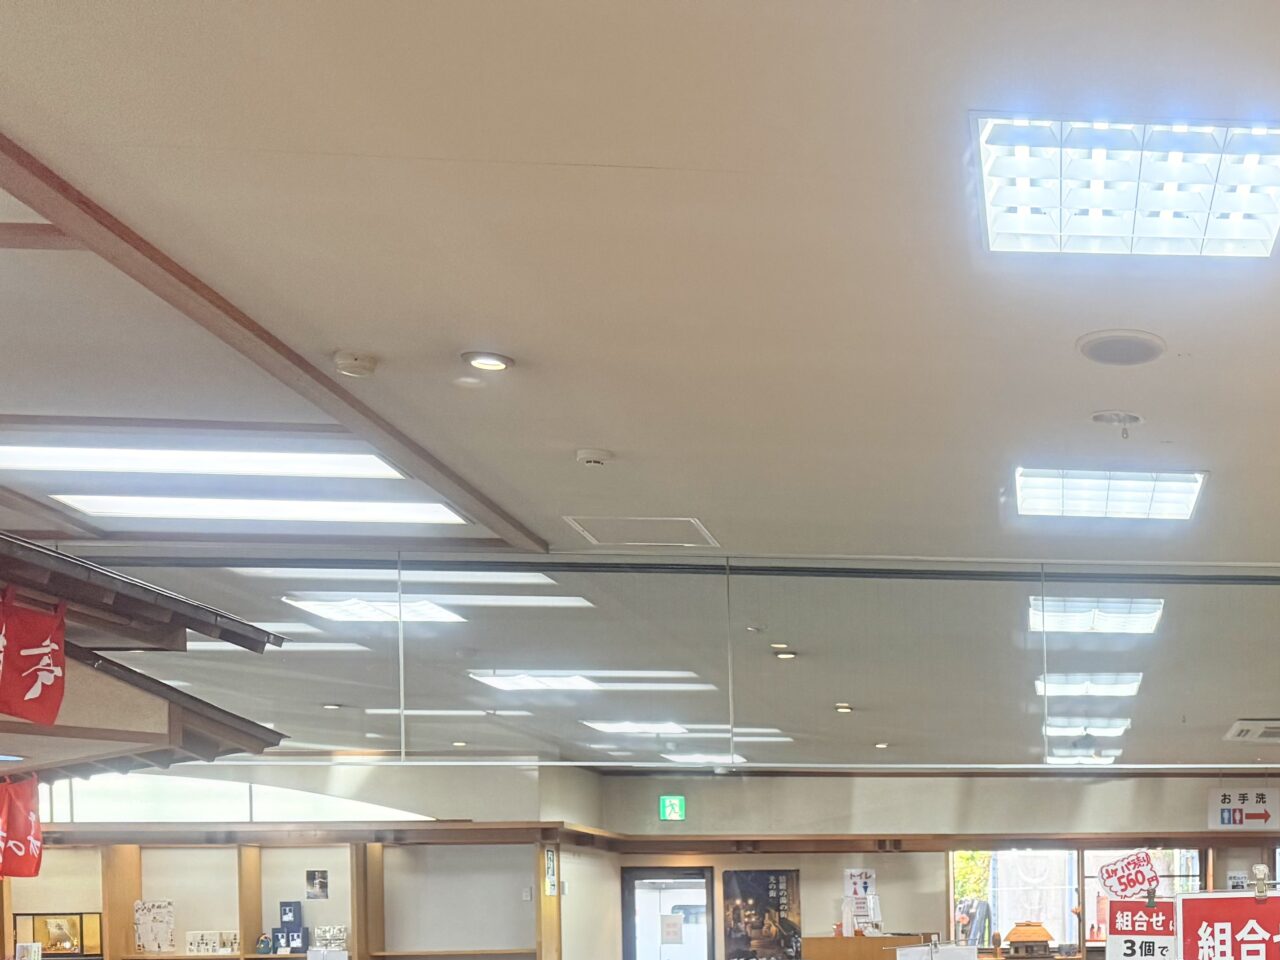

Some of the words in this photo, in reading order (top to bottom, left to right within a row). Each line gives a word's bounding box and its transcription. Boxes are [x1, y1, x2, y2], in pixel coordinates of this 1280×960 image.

[1220, 792, 1267, 805] お手洗
[1122, 939, 1170, 958] 3個で
